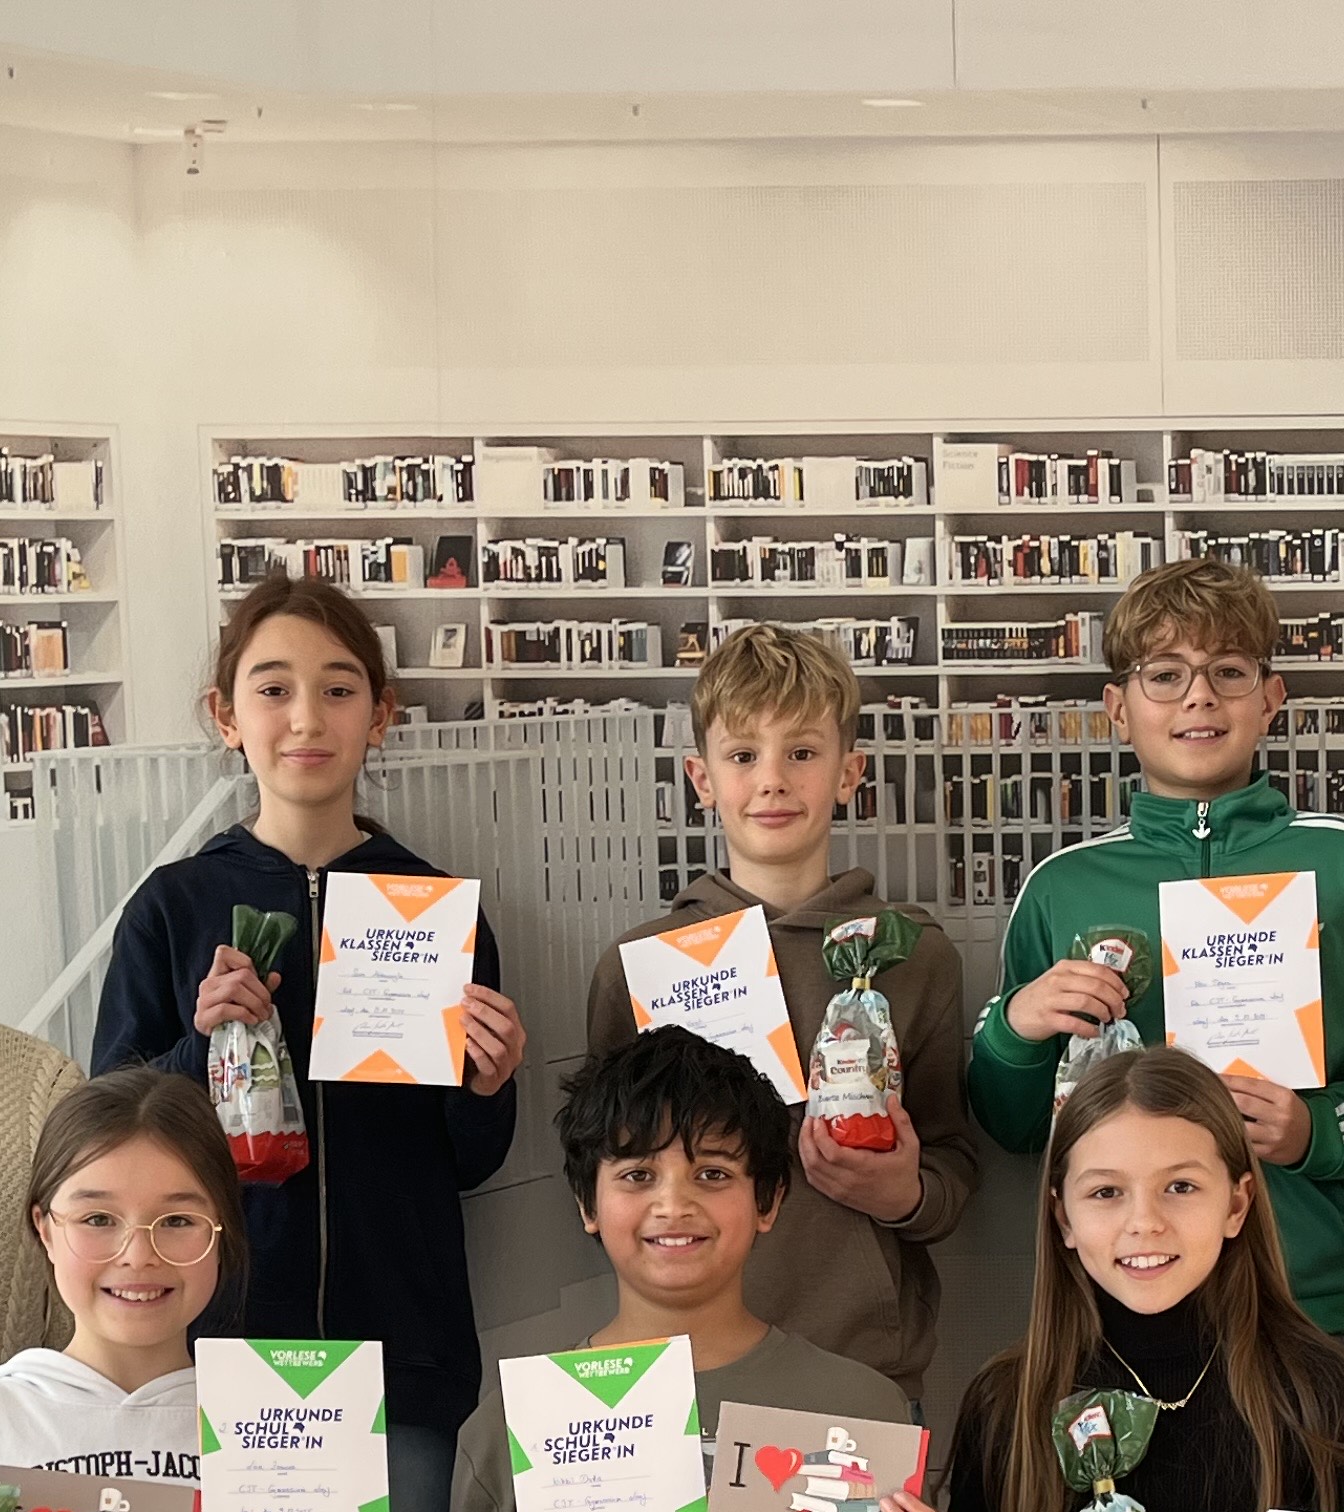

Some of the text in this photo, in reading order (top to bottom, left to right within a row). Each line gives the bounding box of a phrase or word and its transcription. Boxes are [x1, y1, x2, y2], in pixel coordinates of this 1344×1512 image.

[366, 928, 435, 942] URKUNDE
[1206, 931, 1276, 946] URKUNDE
[340, 938, 401, 951] KLASSEN
[1181, 944, 1244, 960] KLASSEN
[672, 967, 737, 993] URKUNDE
[651, 986, 708, 1010] KLASSEN
[270, 1350, 316, 1360] VORLESE
[574, 1358, 623, 1371] VORLESE
[260, 1408, 343, 1422] URKUNDE
[234, 1422, 289, 1435] SCHUL
[568, 1414, 654, 1435] URKUNDE
[544, 1434, 600, 1452] SCHUL
[729, 1441, 751, 1488] I
